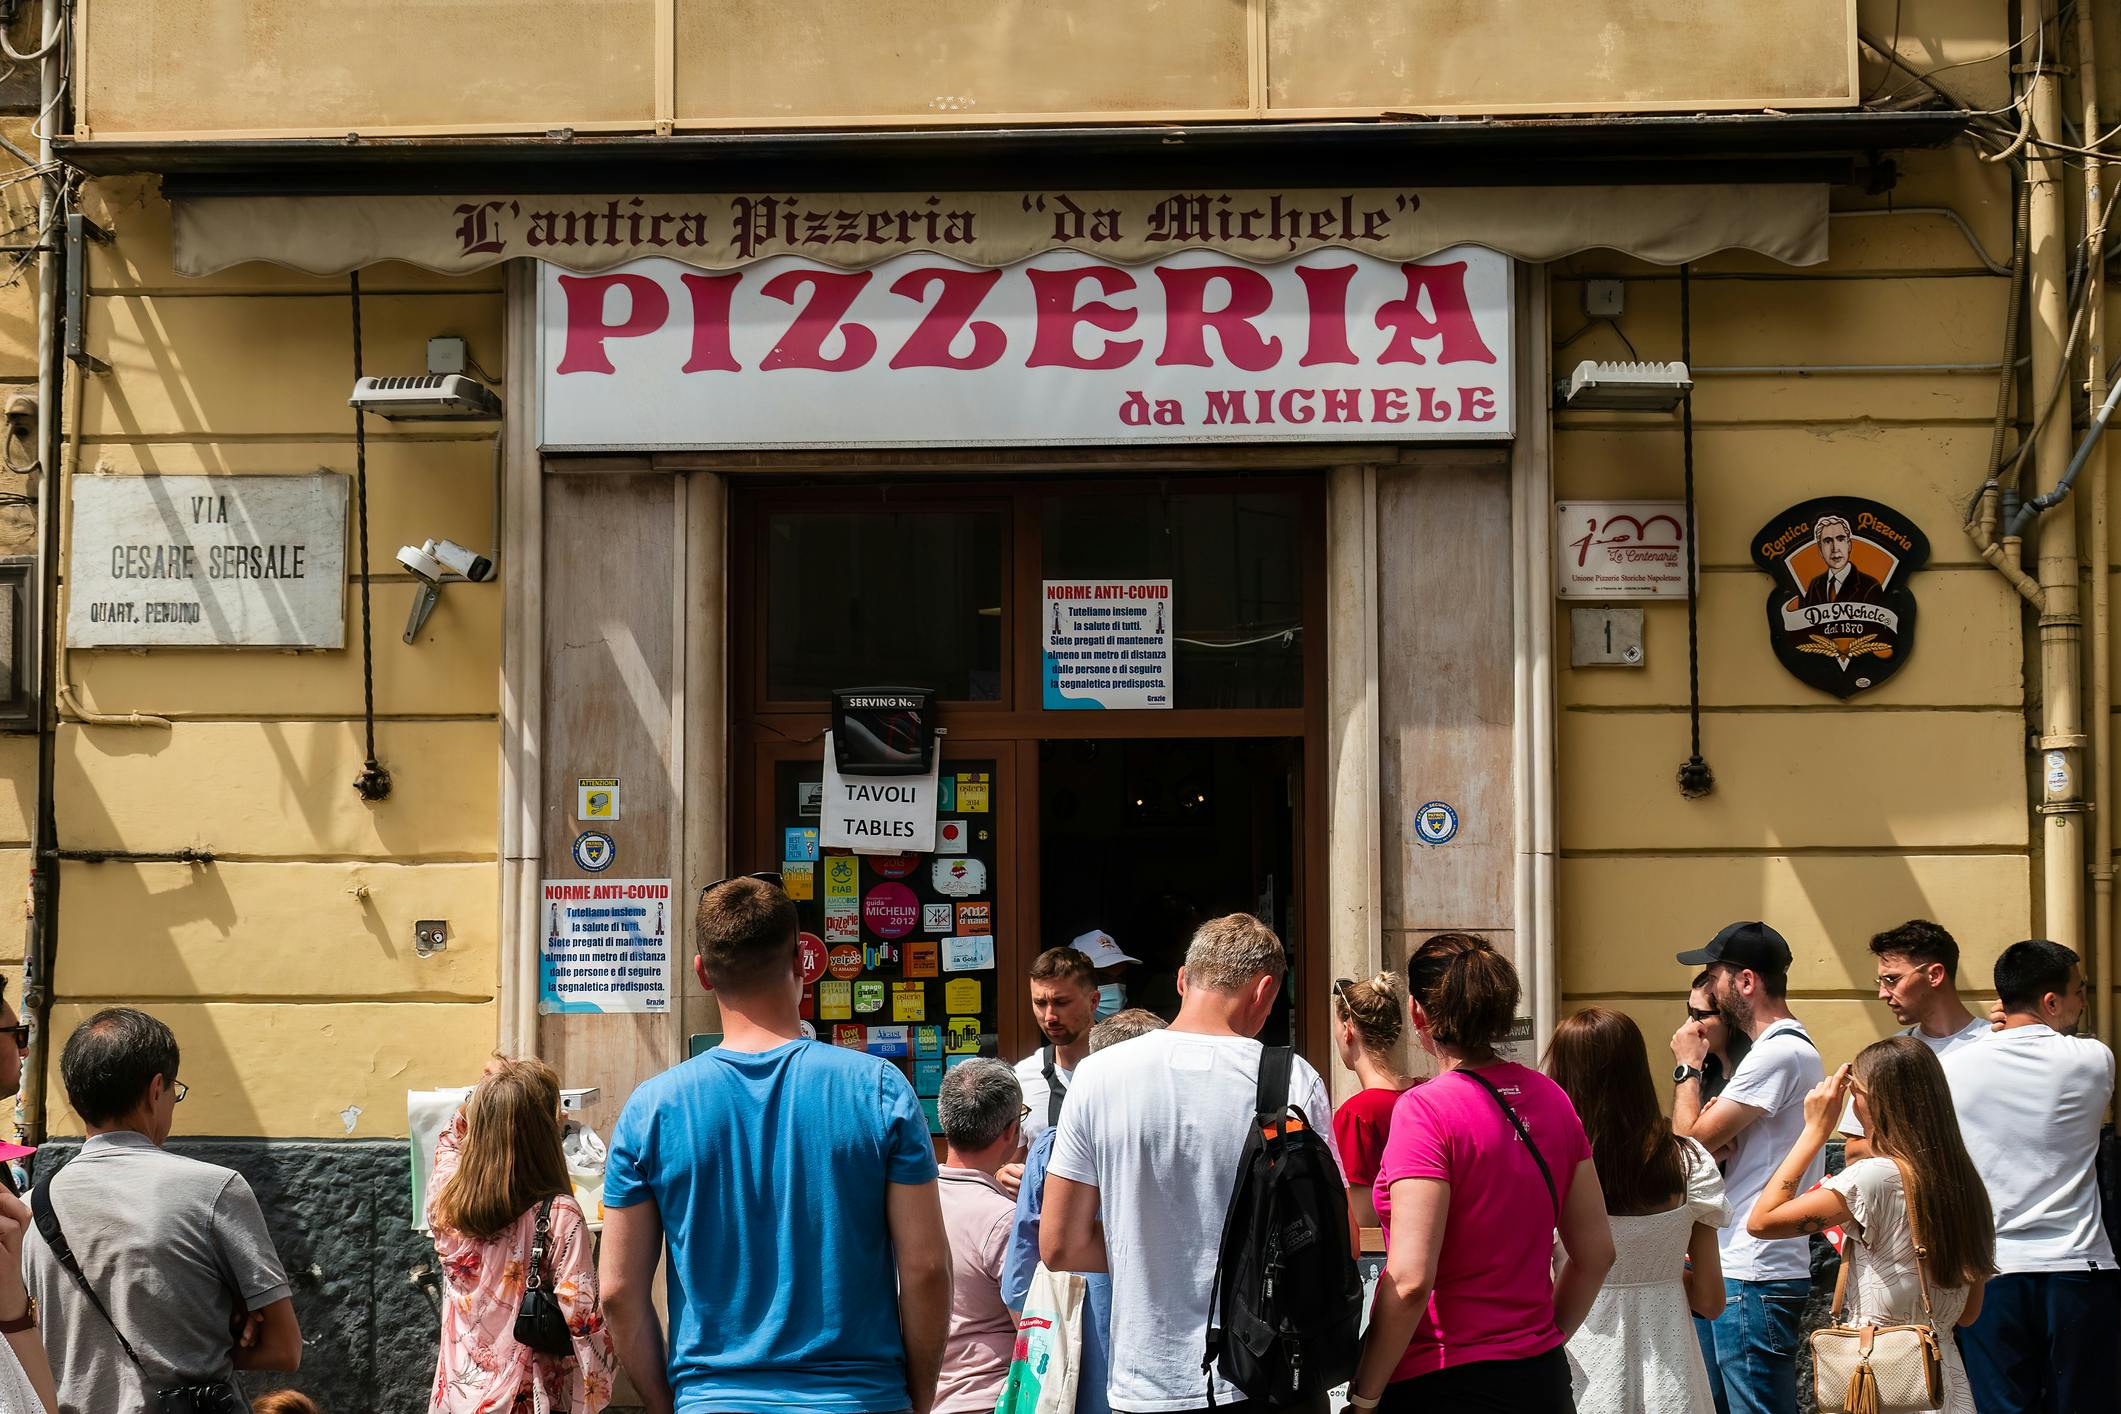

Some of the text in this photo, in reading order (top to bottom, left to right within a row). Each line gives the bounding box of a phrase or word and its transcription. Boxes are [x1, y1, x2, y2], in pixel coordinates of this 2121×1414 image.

[455, 196, 709, 253] L'antica
[732, 194, 977, 259] Pizzeria
[556, 261, 1497, 376] PIZZERIA
[1120, 386, 1496, 426] da MICHELE
[192, 496, 228, 523] VIA
[1858, 512, 1912, 551] Pizzeria
[112, 545, 305, 580] CESARE SERSALE
[1048, 586, 1168, 599] NORME ANTI-COVID
[91, 602, 200, 624] QUART. PENDINO
[1068, 607, 1146, 616] Tuteliamo insieme
[1804, 605, 1830, 625] Da
[1074, 622, 1141, 630] la salute di tutti.
[1824, 624, 1863, 635] dal 1870
[1051, 636, 1163, 646] Siete pregati di mantenere
[1604, 620, 1611, 654] 1
[1048, 651, 1079, 659] almeno
[1094, 651, 1119, 659] metro
[1121, 650, 1129, 659] di
[1131, 650, 1166, 659] distanza
[1052, 665, 1073, 674] dalle
[1076, 666, 1110, 674] persone
[1119, 665, 1127, 673] di
[1129, 665, 1161, 674] seguire
[1051, 679, 1165, 689] la segnaletica predisposta.
[850, 698, 916, 707] SERVING No.
[845, 784, 915, 803] TAVOLI
[844, 819, 914, 837] TABLES
[545, 885, 668, 899] NORME ANTI-COVID
[567, 907, 646, 917] Tuteliamo insieme
[866, 907, 915, 916] MICHELIN
[960, 907, 988, 916] 2012
[572, 922, 640, 932] la salute di tutti.
[826, 913, 858, 931] pizzerie
[549, 937, 662, 948] Siete pregati di mantenere
[545, 952, 577, 962] almeno
[592, 953, 617, 961] metro
[620, 952, 628, 961] di
[630, 952, 665, 961] distanza
[830, 955, 851, 965] yelp
[550, 968, 571, 976] dalle
[574, 968, 608, 977] persone
[618, 967, 626, 976] di
[628, 967, 661, 977] seguire
[548, 982, 664, 992] la segnaletica predisposta.
[841, 1028, 858, 1038] low
[919, 1026, 934, 1037] low
[843, 1036, 860, 1044] cost
